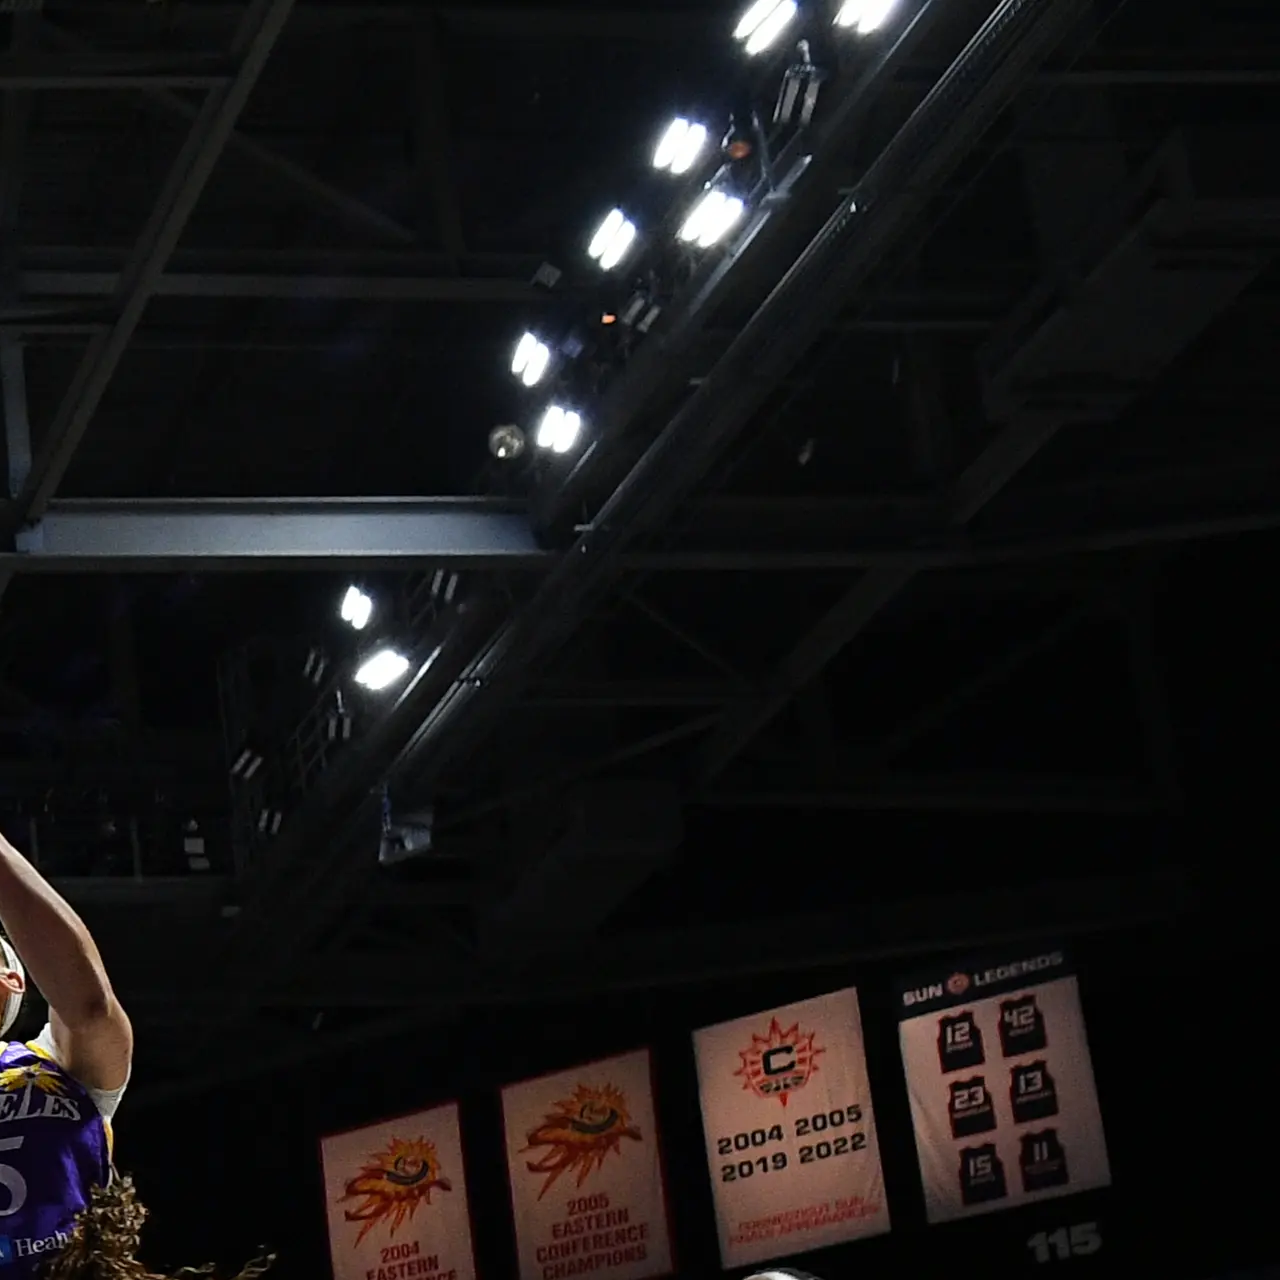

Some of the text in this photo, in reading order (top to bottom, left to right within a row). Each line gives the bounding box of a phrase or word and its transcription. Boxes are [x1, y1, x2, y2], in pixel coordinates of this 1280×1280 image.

[902, 951, 1064, 1007] SUN LEGENDS
[945, 1005, 1036, 1044] 12 42
[953, 1070, 1044, 1106] 23 13
[717, 1104, 863, 1155] 2004 2005
[722, 1132, 867, 1182] 2019 2022
[552, 1208, 630, 1239] EASTERN
[567, 1193, 611, 1215] 2005
[380, 1241, 421, 1263] 2004
[536, 1223, 649, 1264] CONFERENCE
[1026, 1221, 1104, 1264] 115
[542, 1246, 648, 1280] CHAMPIONS
